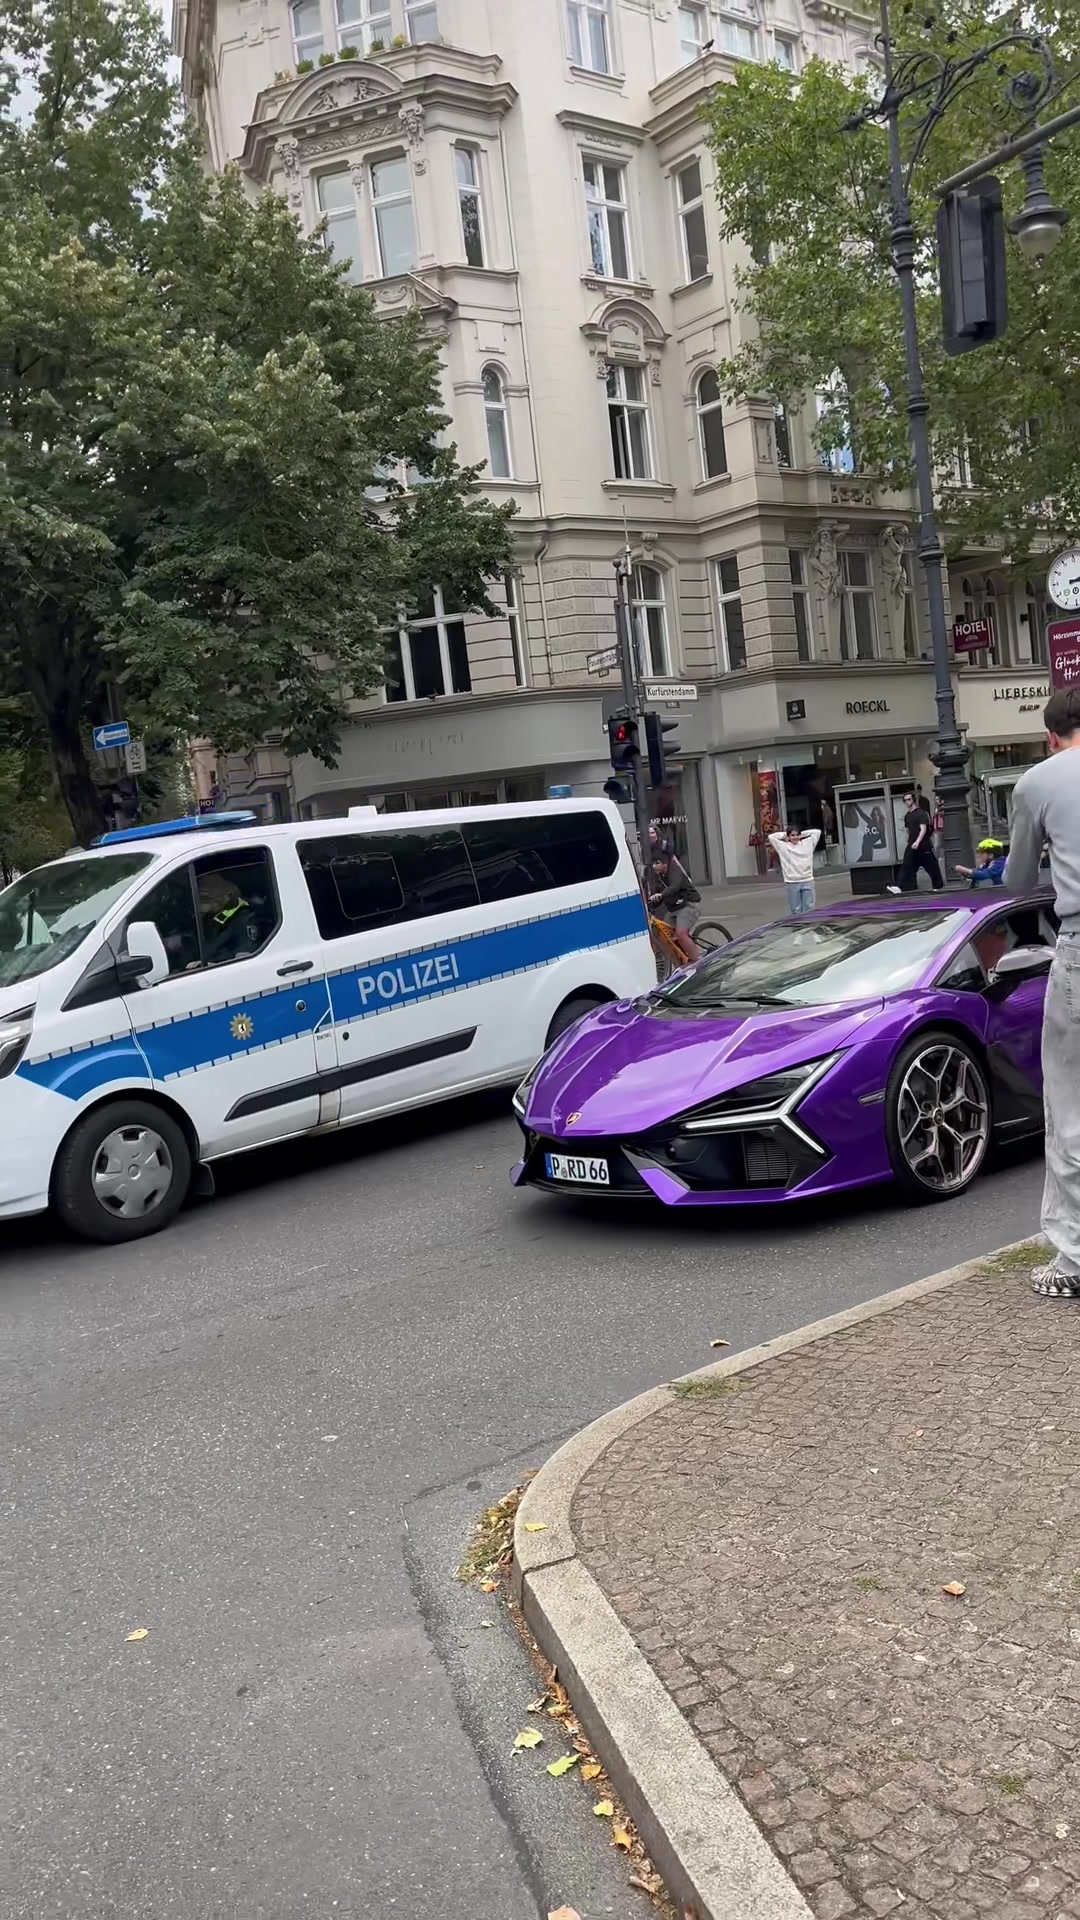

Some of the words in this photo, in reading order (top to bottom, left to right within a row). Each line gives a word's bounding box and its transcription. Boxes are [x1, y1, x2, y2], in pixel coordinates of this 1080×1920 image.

[954, 620, 987, 636] HOTEL
[647, 686, 695, 697] Kurfürstendamm
[845, 700, 890, 714] ROECKL
[357, 953, 460, 1005] POLIZEI
[552, 1157, 560, 1176] P
[567, 1159, 587, 1179] RD
[590, 1160, 607, 1181] 66
